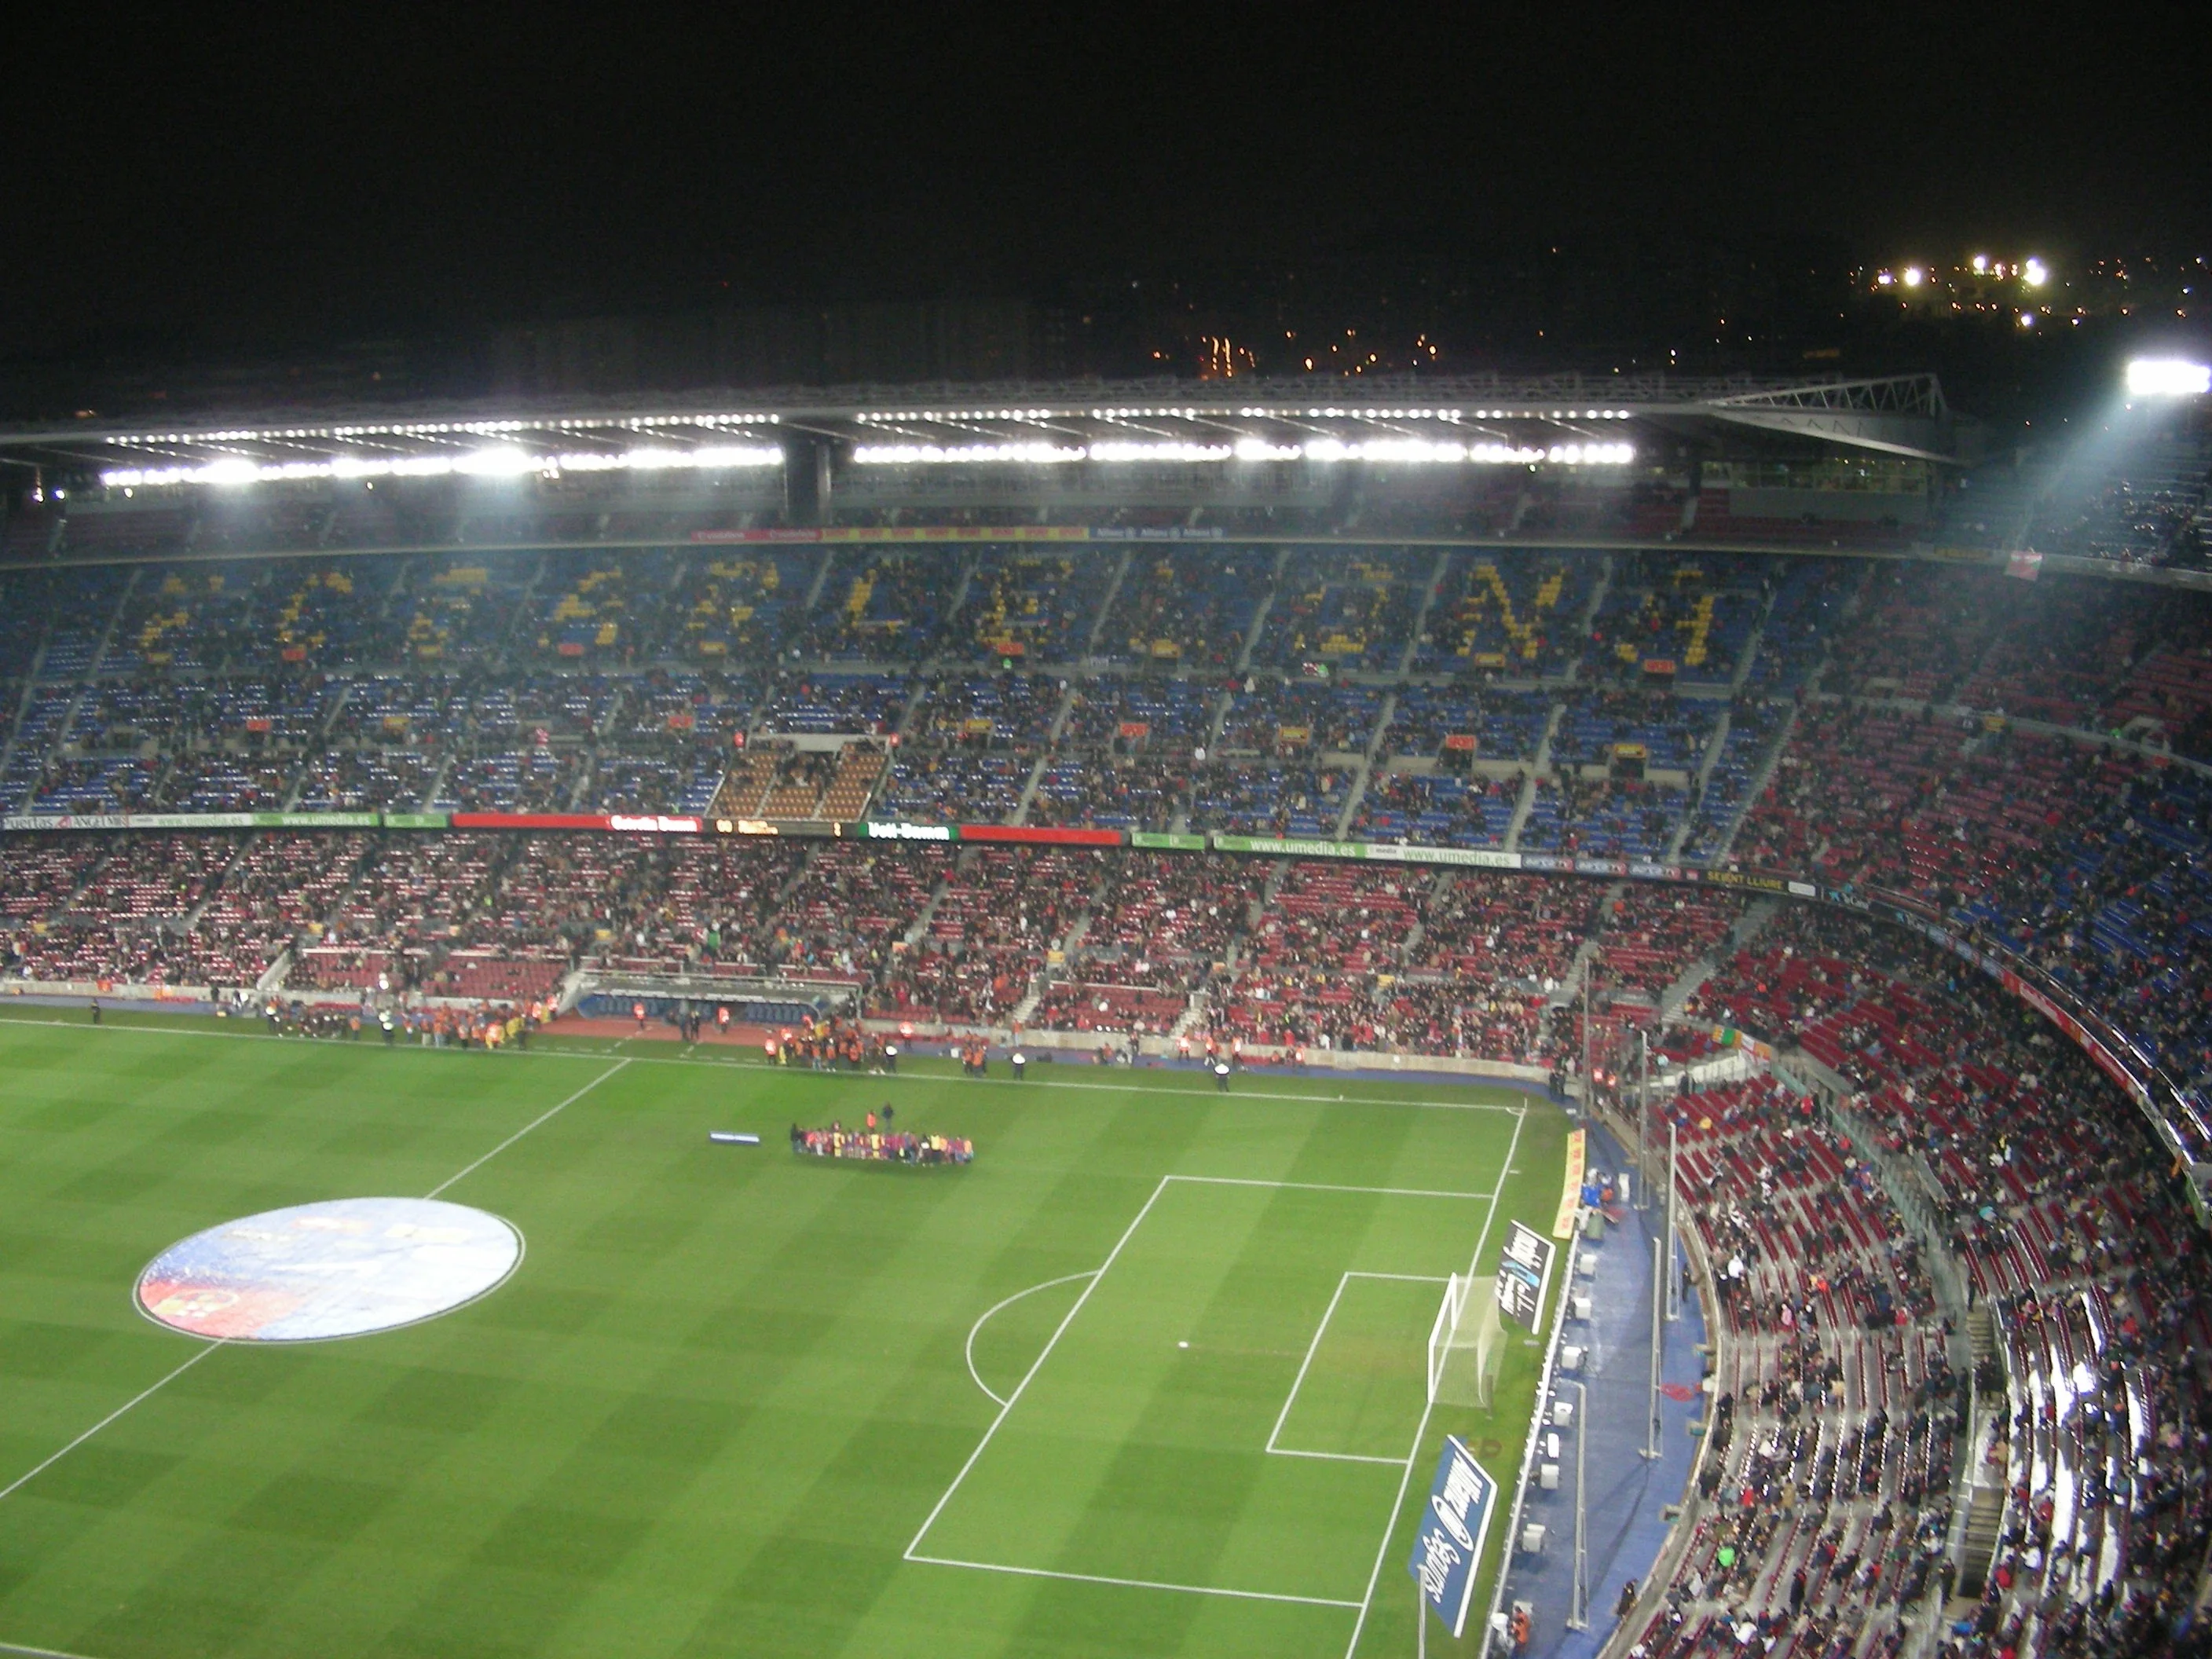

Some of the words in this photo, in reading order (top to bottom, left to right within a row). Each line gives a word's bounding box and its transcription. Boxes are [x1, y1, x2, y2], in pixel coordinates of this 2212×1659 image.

[282, 813, 371, 826] www.umedia.es
[1251, 837, 1356, 857] www.umedia.es
[1403, 848, 1510, 866] www.umedia.es
[1443, 1451, 1483, 1522] Allianz
[1423, 1528, 1461, 1604] Seguros
